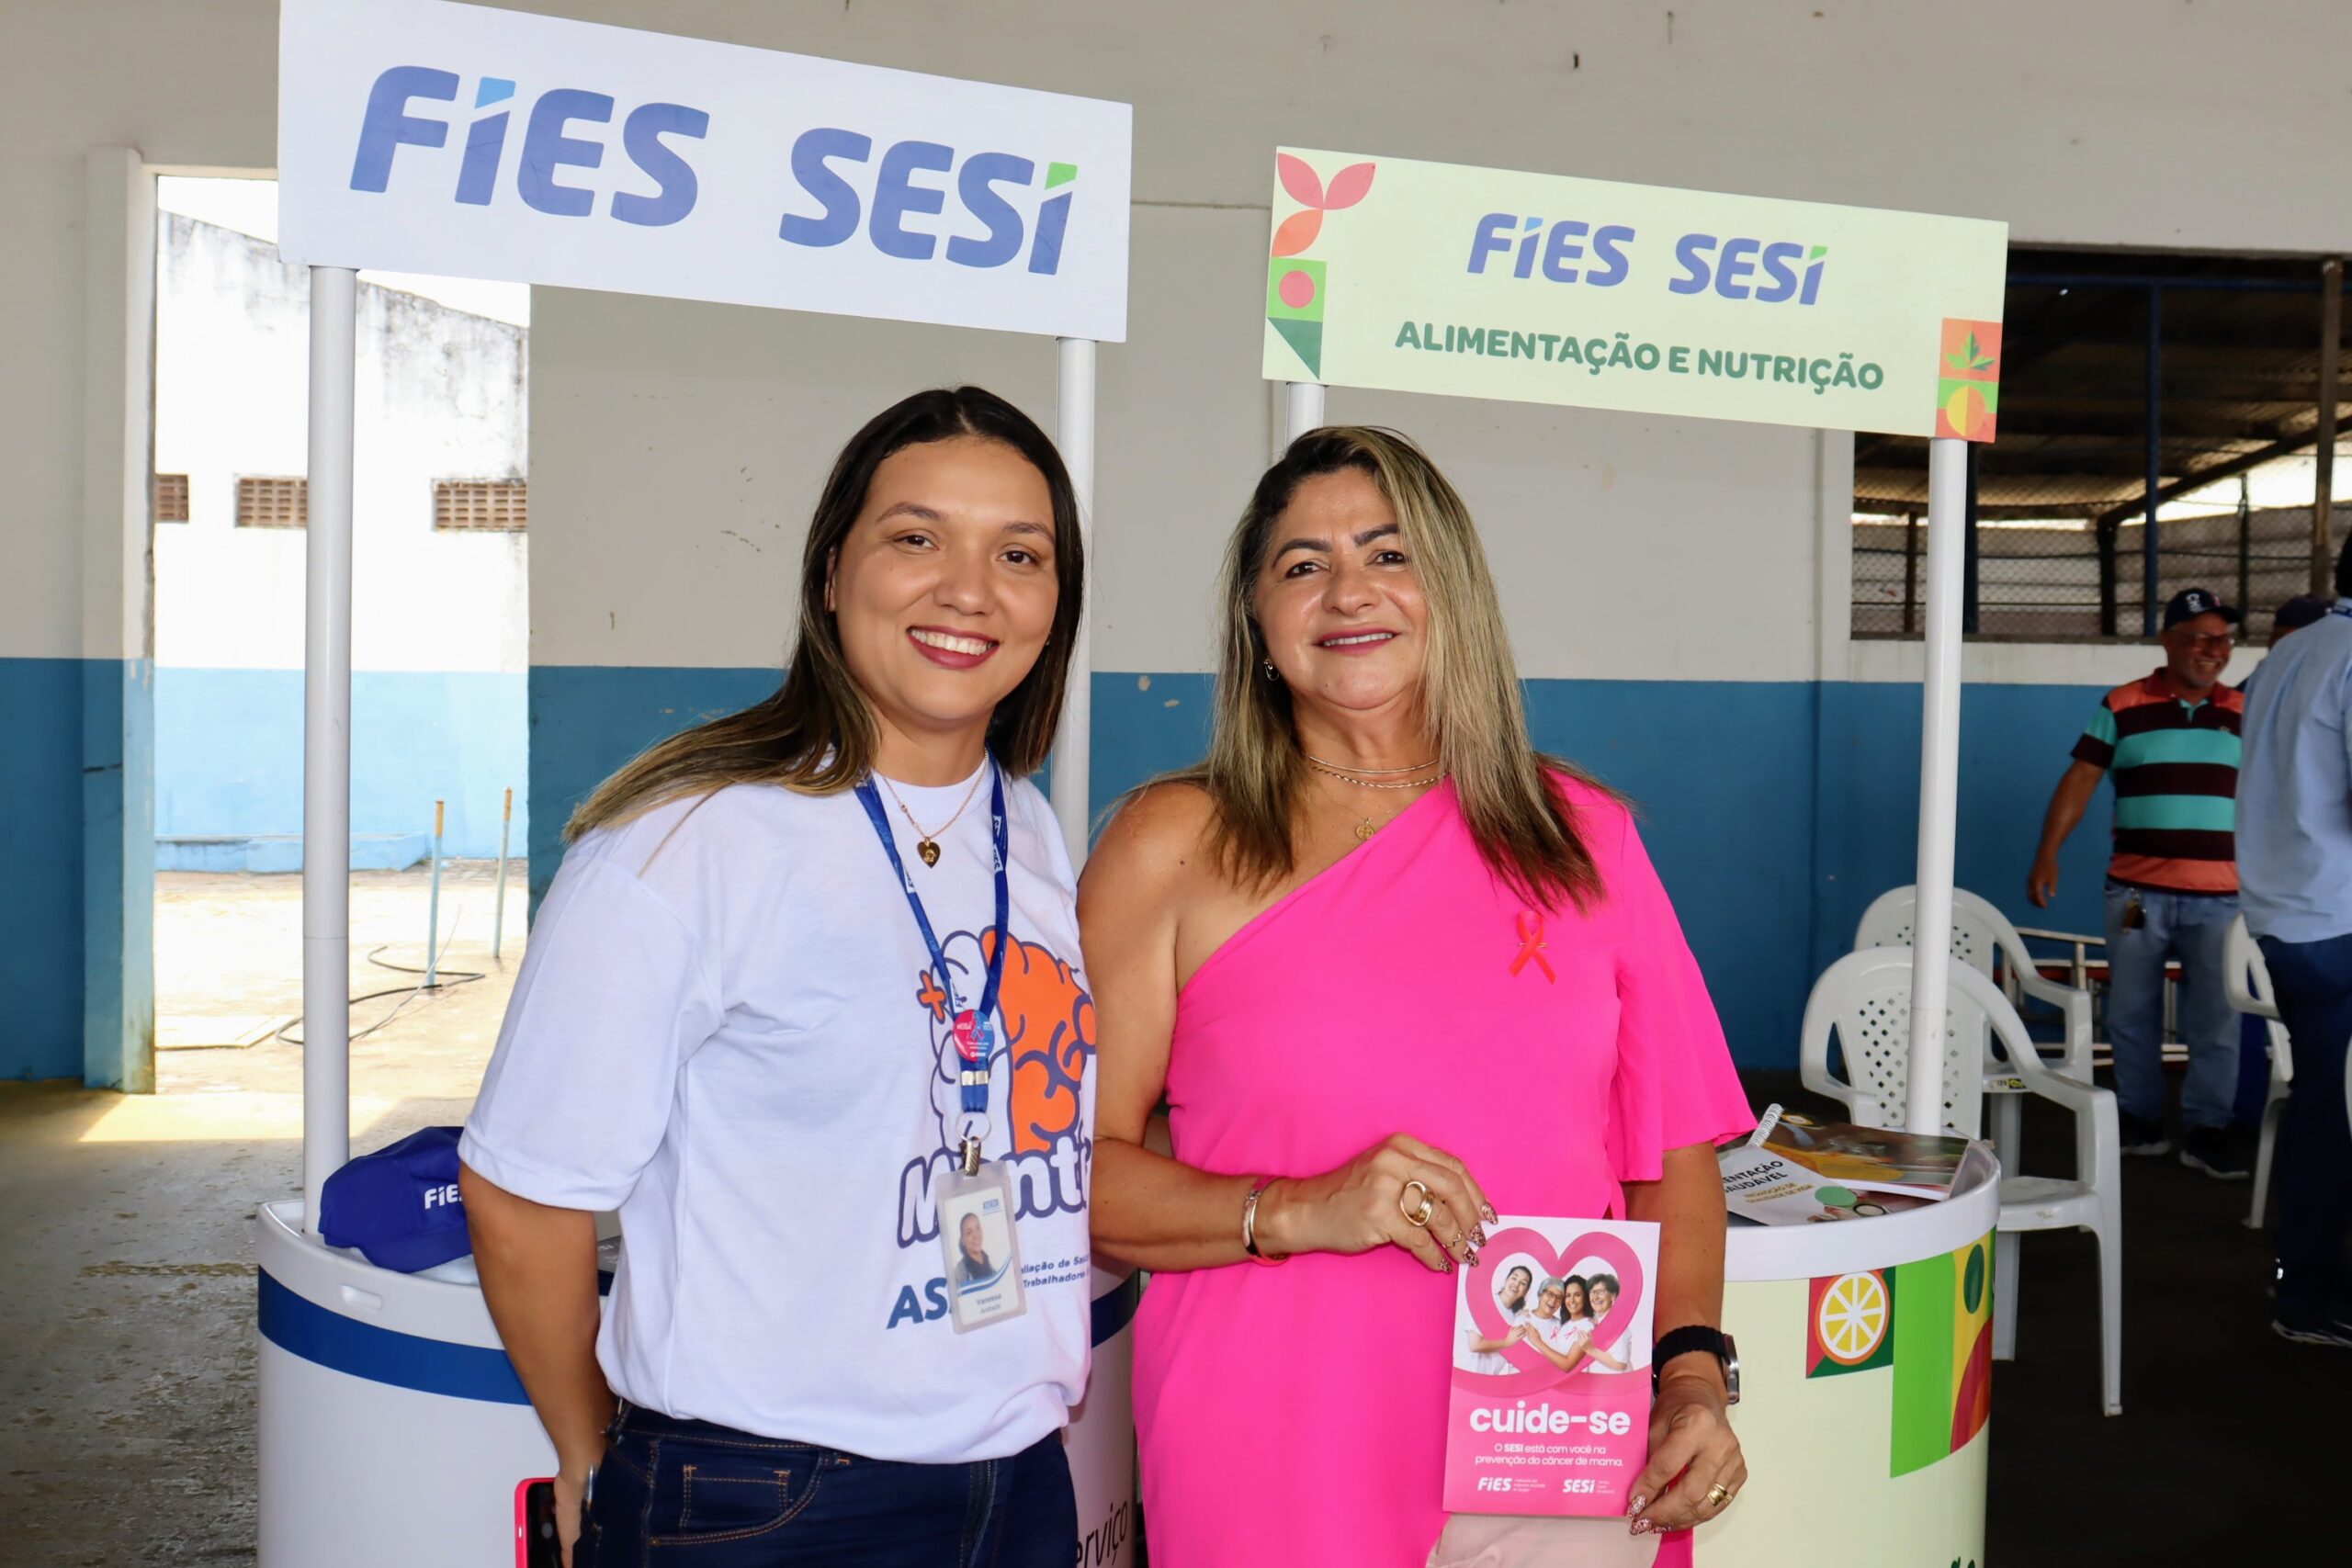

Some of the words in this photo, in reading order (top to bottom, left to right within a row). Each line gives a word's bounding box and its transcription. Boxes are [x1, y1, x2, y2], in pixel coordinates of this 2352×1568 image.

[1395, 321, 1661, 376] ALIMENTAÇÃO
[1668, 345, 1690, 374] E
[1697, 348, 1884, 396] NUTRIÇÃO
[1722, 1160, 1783, 1184] ENTAÇÃO
[1058, 1259, 1070, 1269] de
[886, 1277, 952, 1329] AS
[1469, 1400, 1631, 1436] cuide-se
[1475, 1454, 1526, 1466] prevenção
[1528, 1456, 1541, 1465] do
[1542, 1455, 1574, 1465] câncer
[1575, 1457, 1588, 1466] de
[1589, 1458, 1623, 1467] mama.
[1494, 1443, 1502, 1452] O
[1504, 1443, 1523, 1453] SESI
[1525, 1443, 1545, 1454] está
[1546, 1446, 1567, 1454] com
[1569, 1444, 1592, 1455] você
